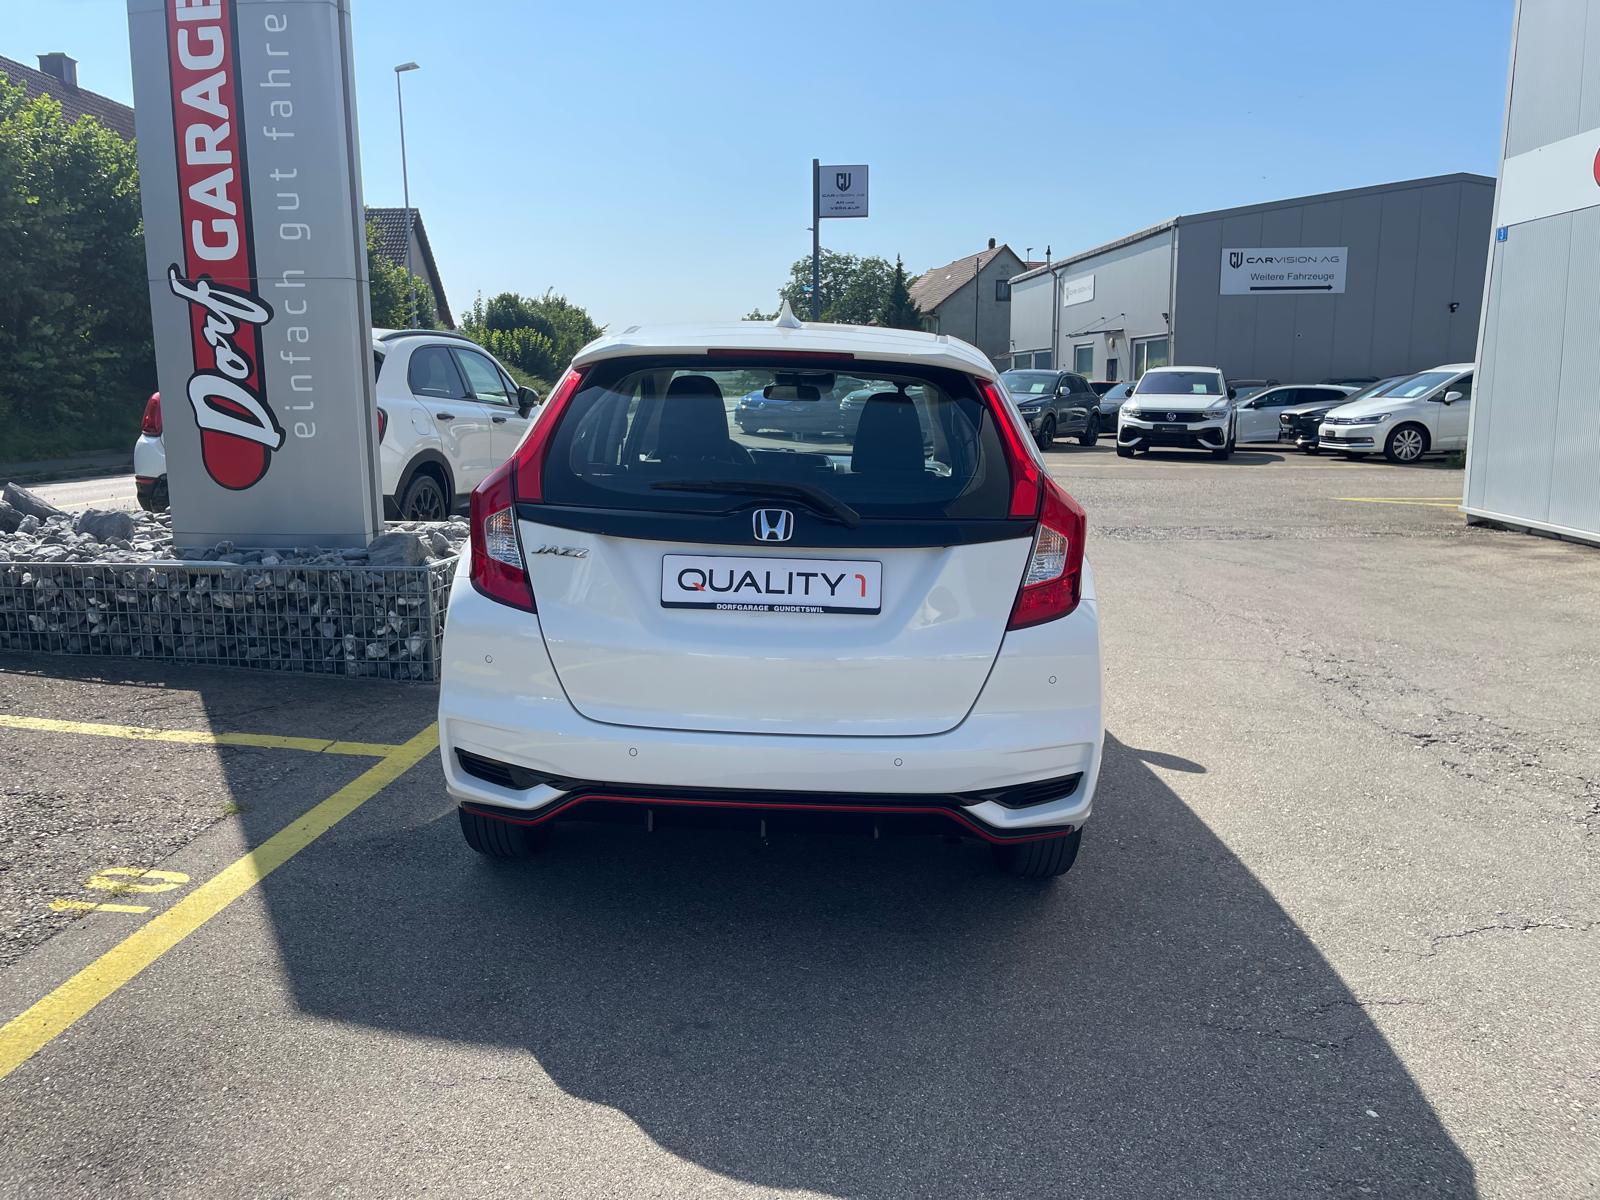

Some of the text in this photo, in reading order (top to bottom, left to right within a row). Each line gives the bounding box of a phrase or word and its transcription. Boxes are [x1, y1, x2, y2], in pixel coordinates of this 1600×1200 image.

[169, 0, 284, 450] Dorf GARAGE
[260, 0, 316, 438] einfach gut fahre
[1246, 255, 1340, 264] CARVISION AG
[1250, 272, 1335, 282] Weitere Fahrzeuge
[531, 544, 590, 558] JAZZ
[677, 568, 847, 597] QUALITY
[716, 603, 824, 613] DORFGARAGE GUNDETSWIL
